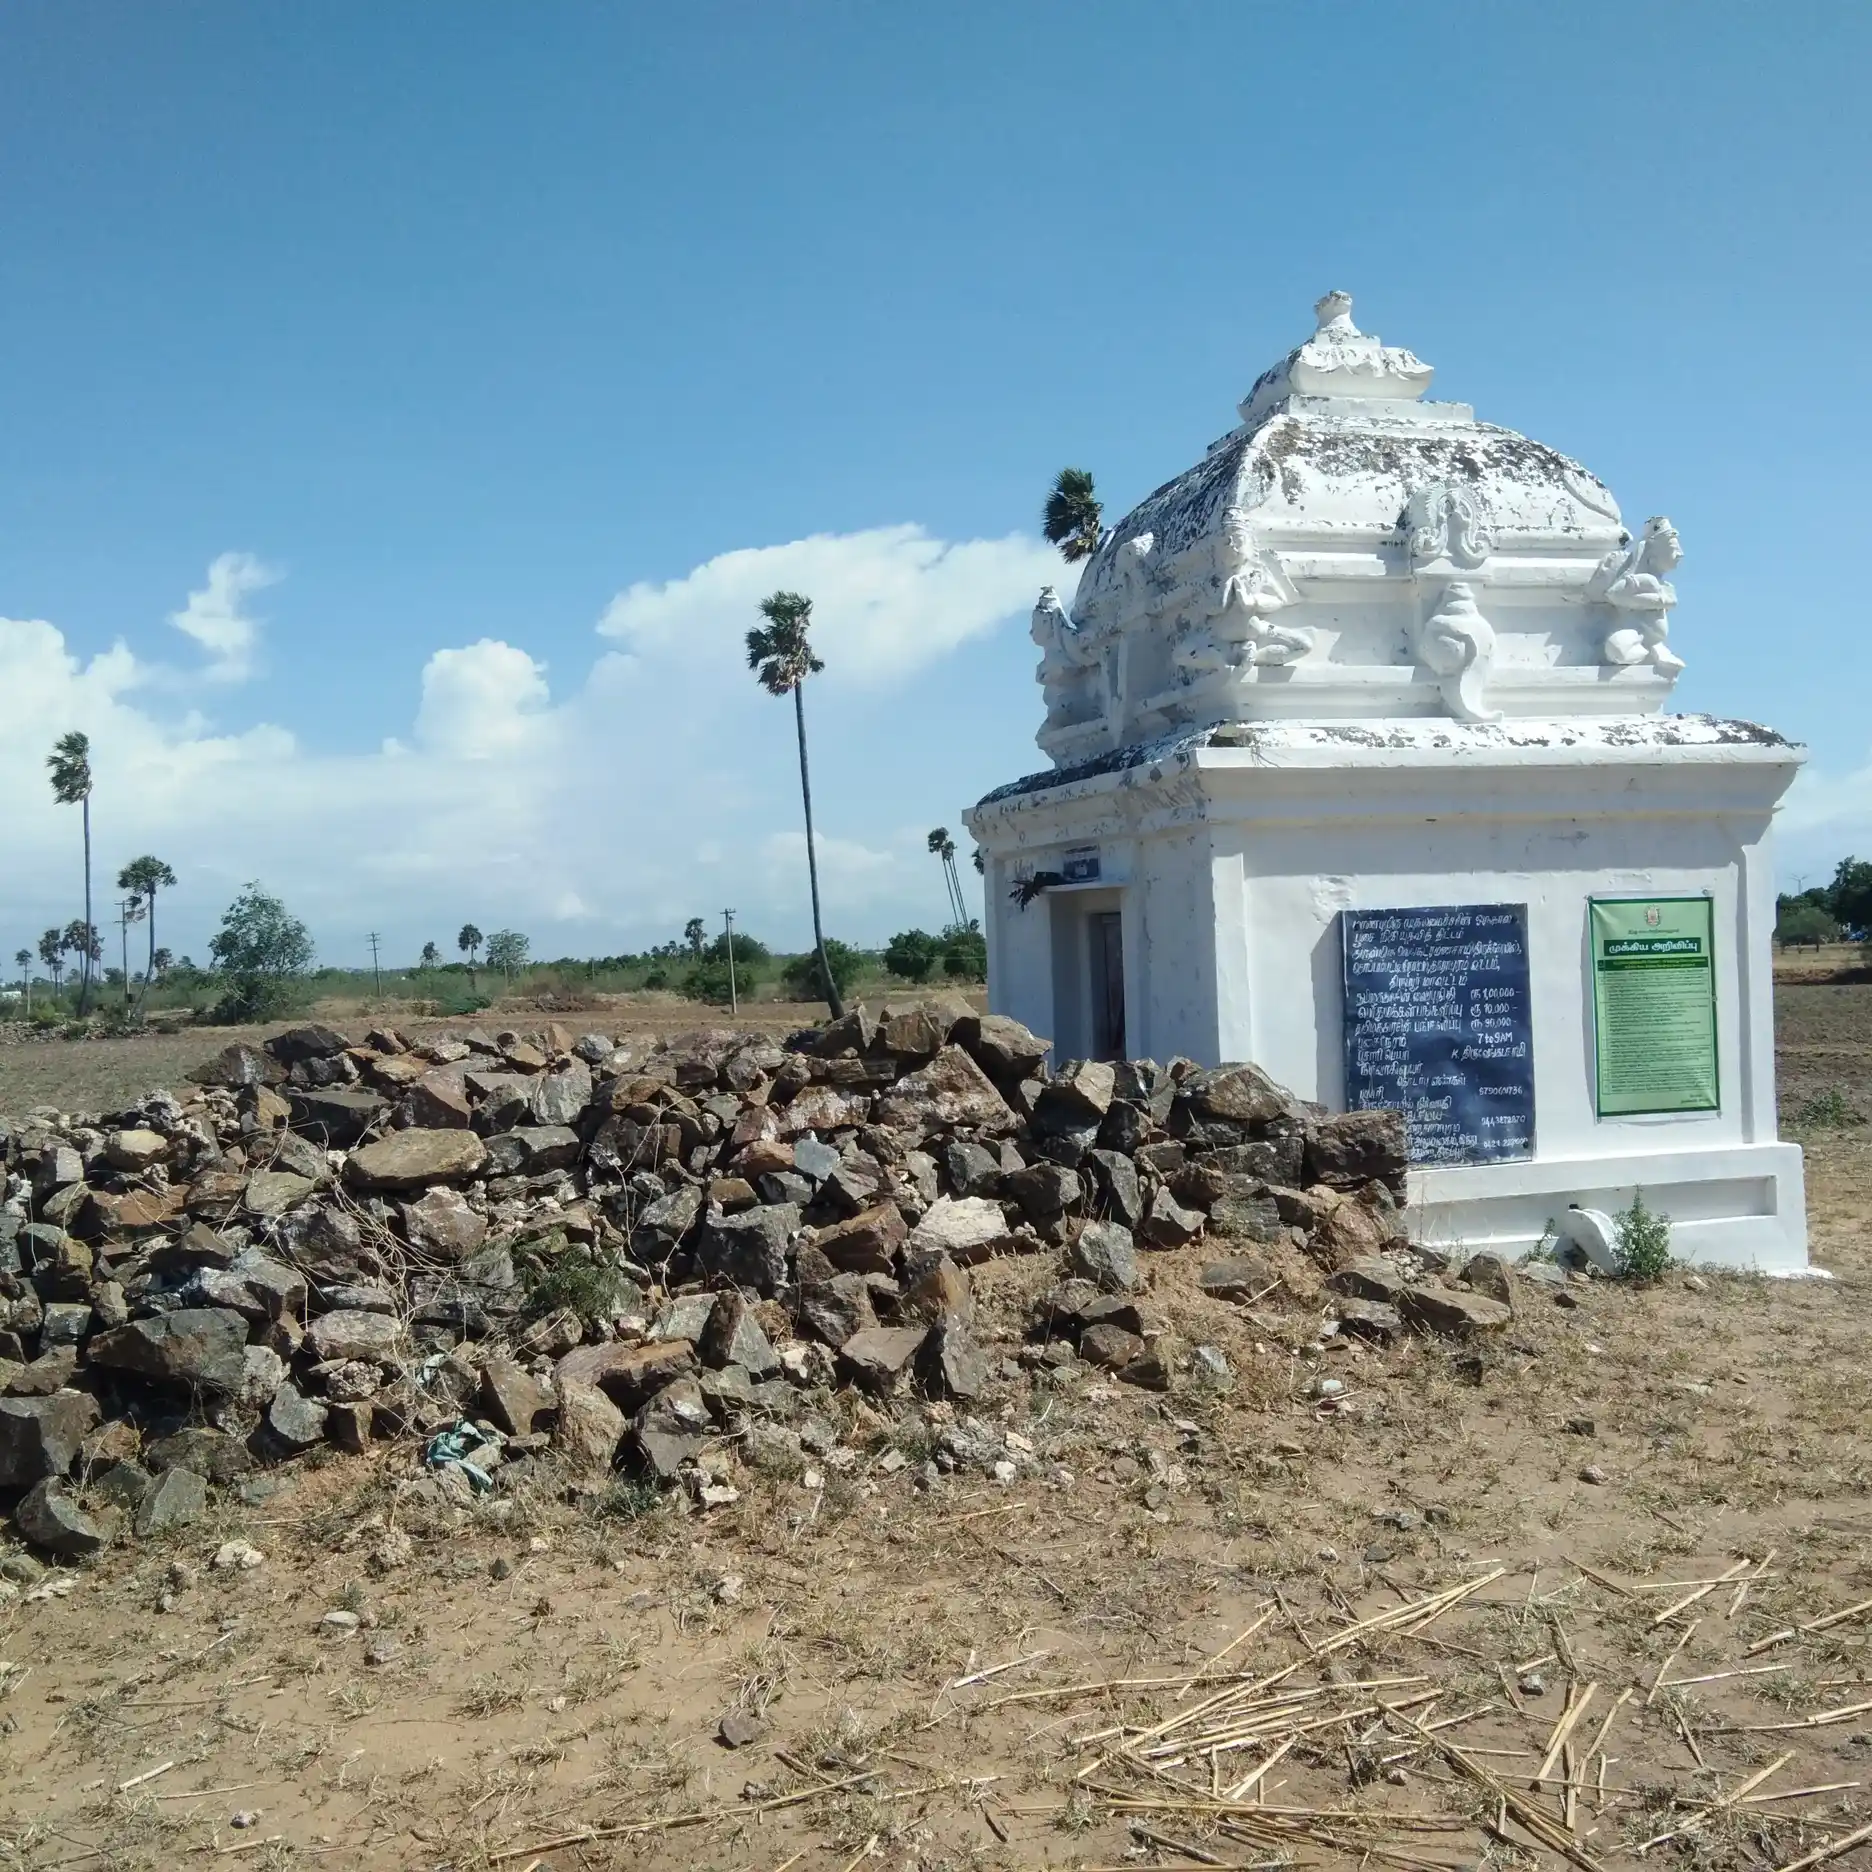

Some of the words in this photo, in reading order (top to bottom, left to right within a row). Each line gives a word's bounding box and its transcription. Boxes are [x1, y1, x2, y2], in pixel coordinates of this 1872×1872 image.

[1435, 927, 1464, 942] திட்டம்
[1608, 941, 1649, 953] முக்கிய
[1651, 939, 1698, 952] அறிவிப்பு
